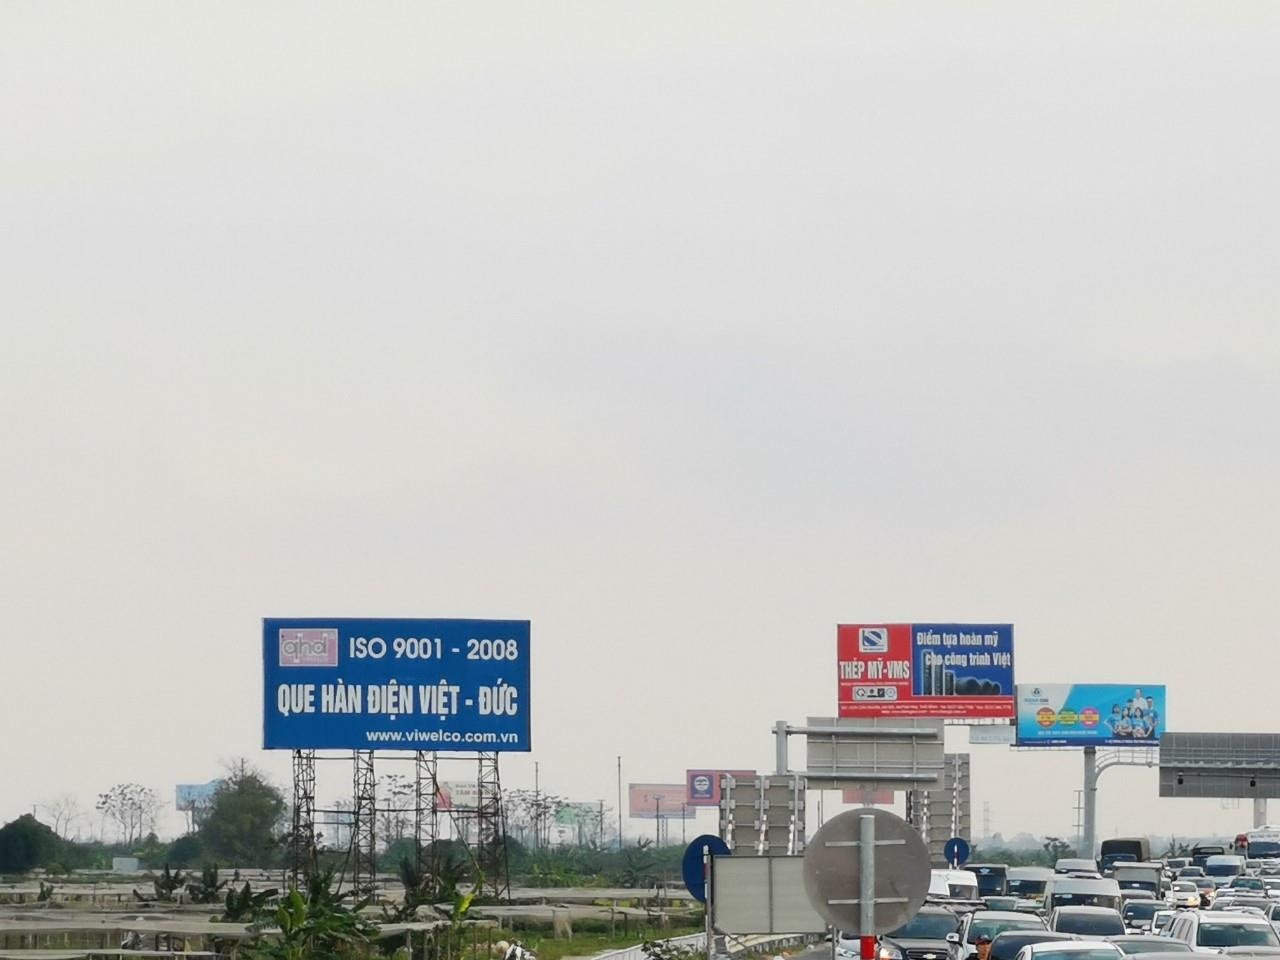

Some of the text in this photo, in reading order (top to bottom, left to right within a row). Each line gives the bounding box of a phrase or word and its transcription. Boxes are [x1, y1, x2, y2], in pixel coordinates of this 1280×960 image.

[350, 637, 387, 659] ISO
[393, 637, 442, 660] 9001
[467, 638, 519, 661] 2008
[839, 657, 911, 680] THÉP MỸ-VMS
[277, 683, 315, 716] QUE
[321, 678, 362, 714] HÀN
[367, 678, 414, 720] ĐIỆN
[419, 678, 461, 720] VIỆT
[478, 678, 518, 716] ĐỨC
[366, 729, 519, 744] www.viwelco.com.vn
